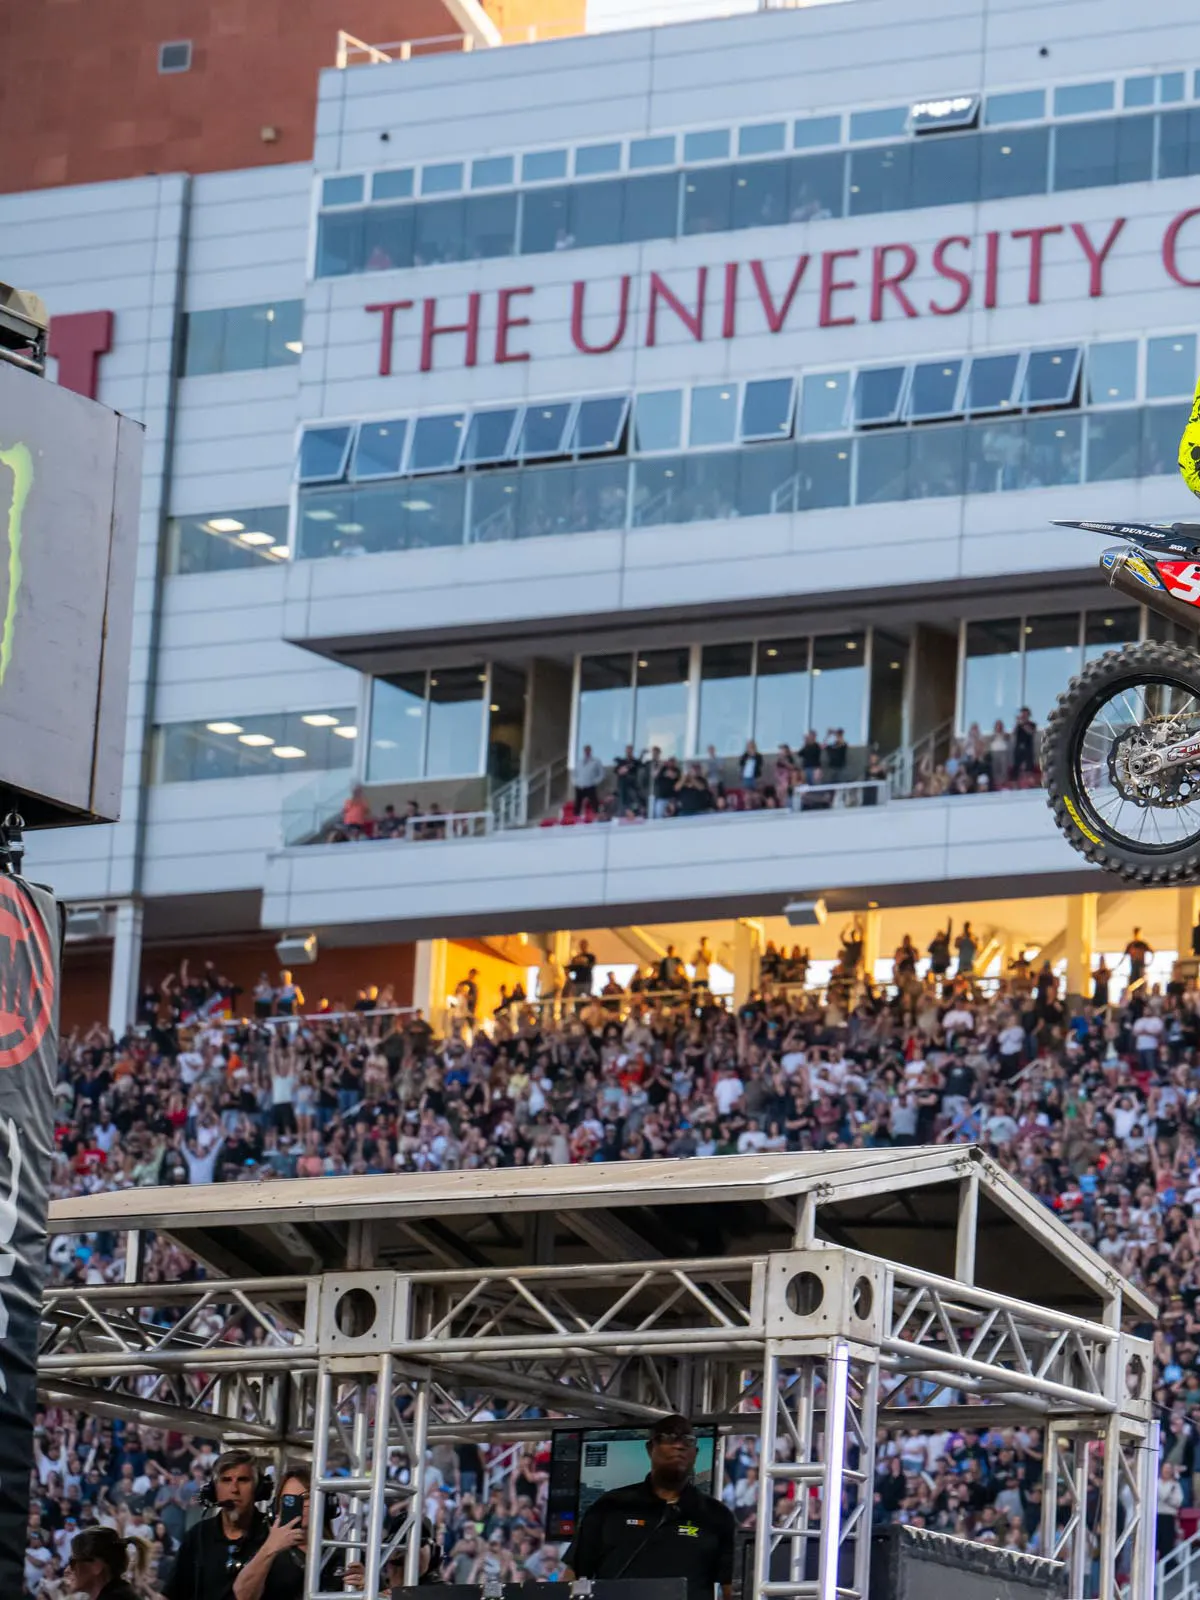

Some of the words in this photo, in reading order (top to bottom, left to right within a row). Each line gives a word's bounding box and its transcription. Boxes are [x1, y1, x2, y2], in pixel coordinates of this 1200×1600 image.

[364, 285, 535, 377] THE
[570, 216, 1127, 355] UNIVERSITY
[1120, 527, 1165, 538] DUNLOP
